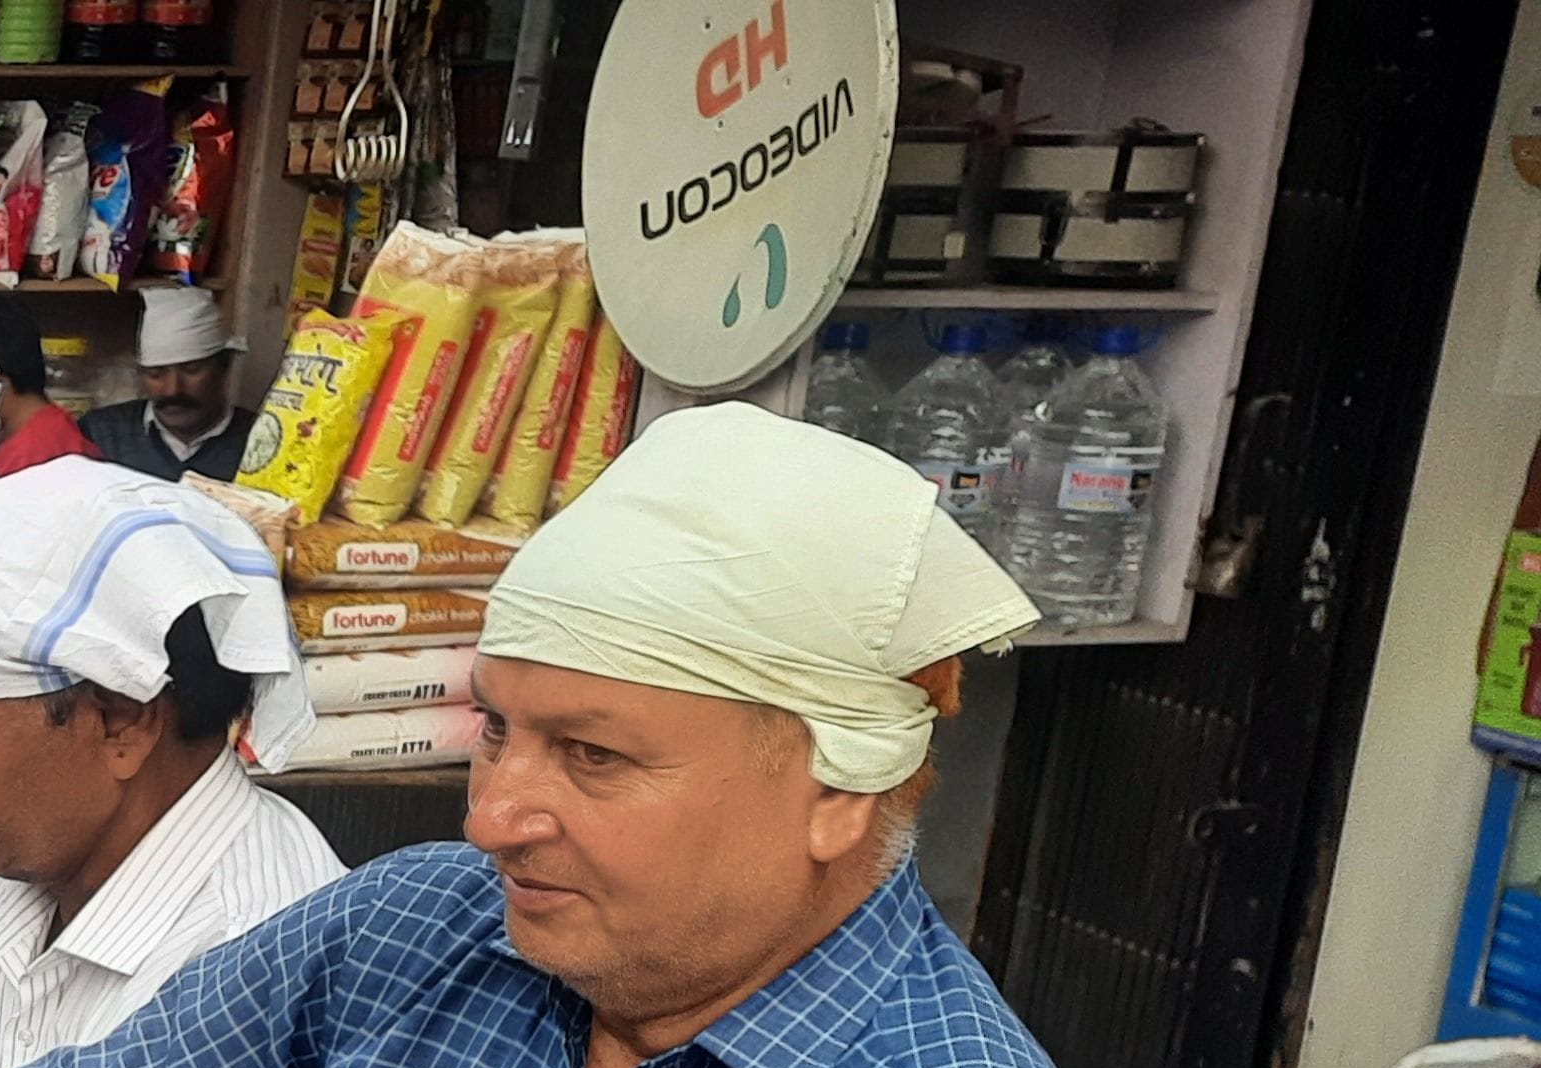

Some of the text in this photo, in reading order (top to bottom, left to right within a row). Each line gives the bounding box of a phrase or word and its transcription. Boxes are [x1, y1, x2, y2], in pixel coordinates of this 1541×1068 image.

[696, 0, 788, 119] HD
[347, 547, 410, 567] fortune
[333, 611, 397, 630] fortune
[413, 682, 447, 700] ATTA
[401, 739, 433, 756] ATTA
